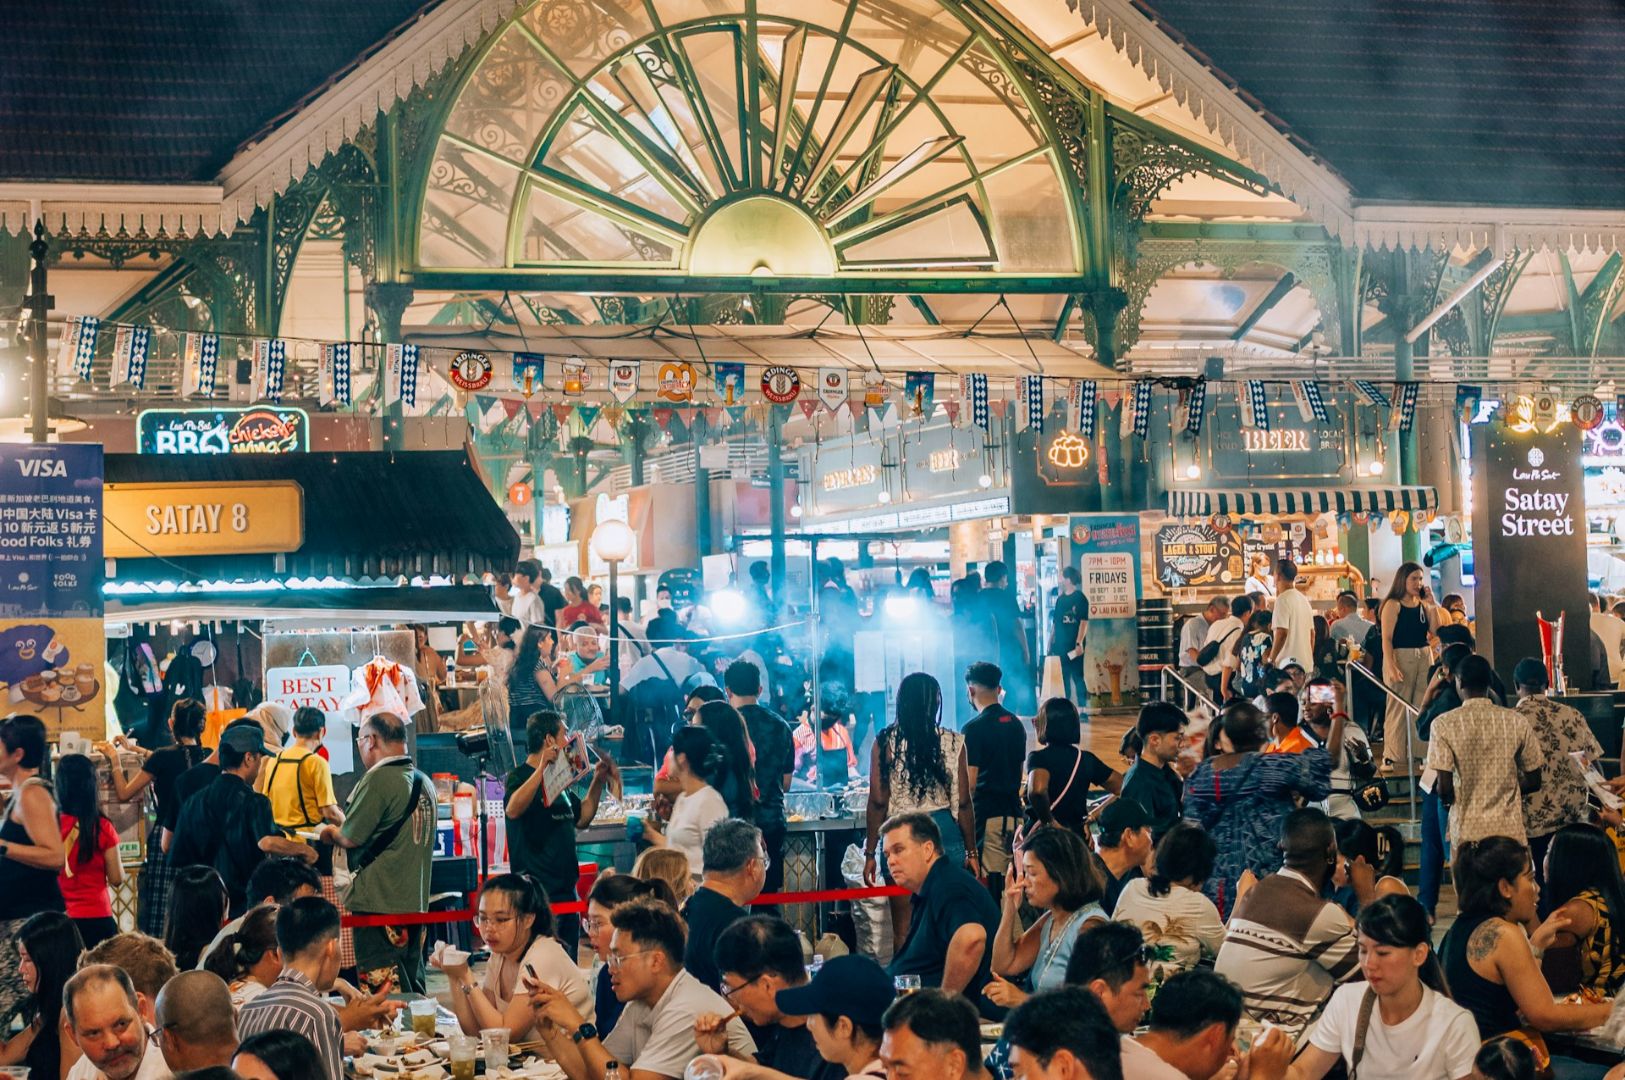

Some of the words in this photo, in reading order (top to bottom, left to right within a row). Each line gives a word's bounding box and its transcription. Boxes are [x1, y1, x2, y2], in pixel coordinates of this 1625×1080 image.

[453, 352, 490, 370] ERDINGER
[763, 367, 798, 383] ERDINGER
[1244, 430, 1311, 451] BEER
[15, 459, 67, 477] VISA
[1505, 487, 1569, 516] Satay
[56, 509, 83, 520] Visa
[85, 508, 97, 520] 卡
[146, 504, 222, 536] SATAY
[232, 503, 248, 533] 8
[1502, 513, 1574, 536] Street
[0, 536, 27, 547] ood
[30, 536, 64, 547] Folks
[66, 536, 92, 548] 礼券
[1162, 543, 1187, 555] LAGER
[1194, 543, 1217, 555] STOUT
[1089, 557, 1102, 566] 7PM
[1110, 557, 1126, 566] 10PM
[1089, 572, 1127, 584] FRIDAYS
[1099, 606, 1110, 614] LAU
[1111, 606, 1118, 614] PA
[1119, 606, 1129, 614] SAT
[282, 676, 336, 695] BEST
[274, 696, 343, 712] ATAY
